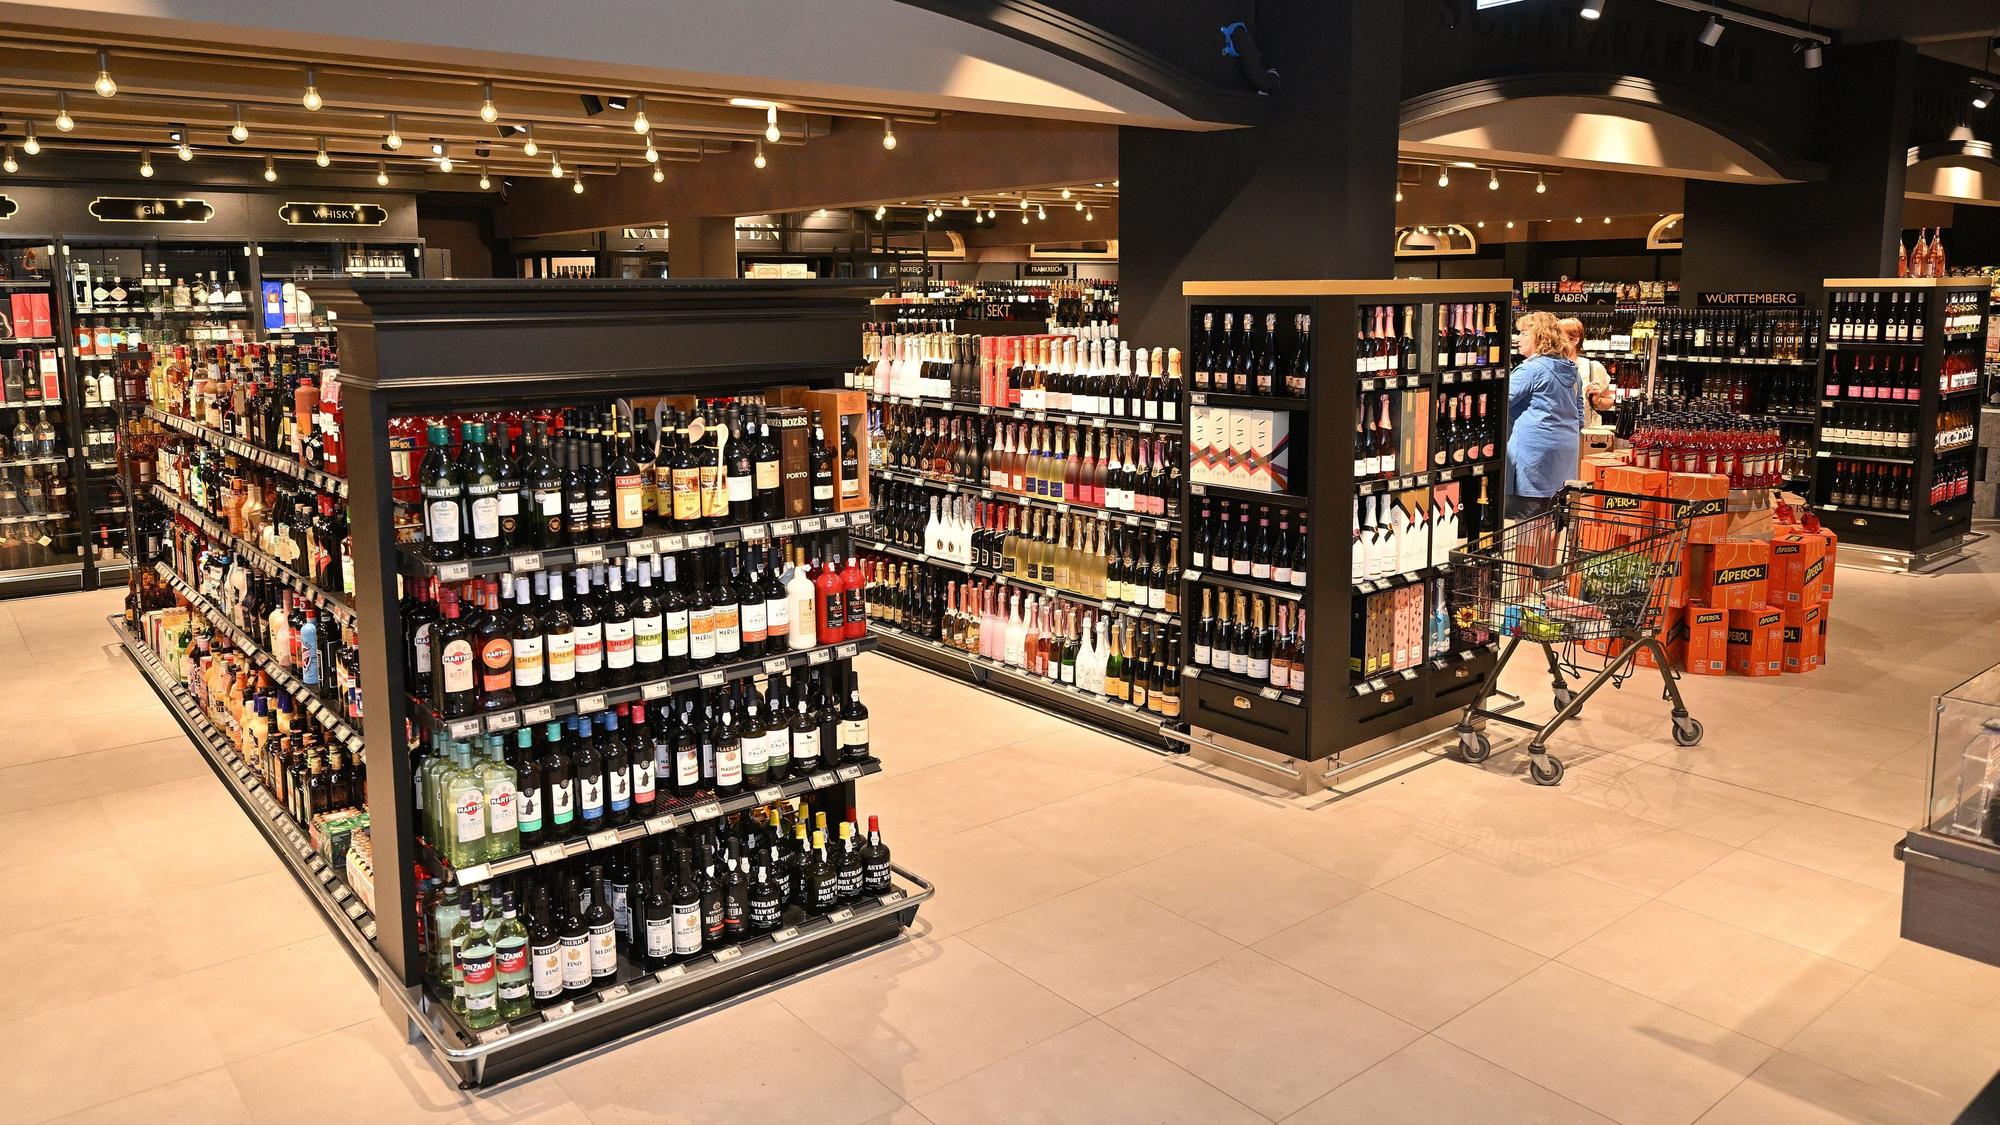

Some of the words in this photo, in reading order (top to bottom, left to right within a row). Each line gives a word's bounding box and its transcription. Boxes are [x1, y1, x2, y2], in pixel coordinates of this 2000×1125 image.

[142, 205, 165, 215] GIN
[313, 210, 356, 219] WHISKY
[1554, 294, 1589, 303] BADEN
[1705, 292, 1797, 304] WÜRTTEMBERG
[986, 304, 1011, 318] SEKT
[782, 416, 808, 427] ROZÈS
[786, 471, 808, 479] PORTO
[1718, 567, 1762, 584] APEROL
[485, 649, 510, 658] MARTINI
[818, 893, 834, 901] PORT
[463, 961, 492, 972] CINZANO
